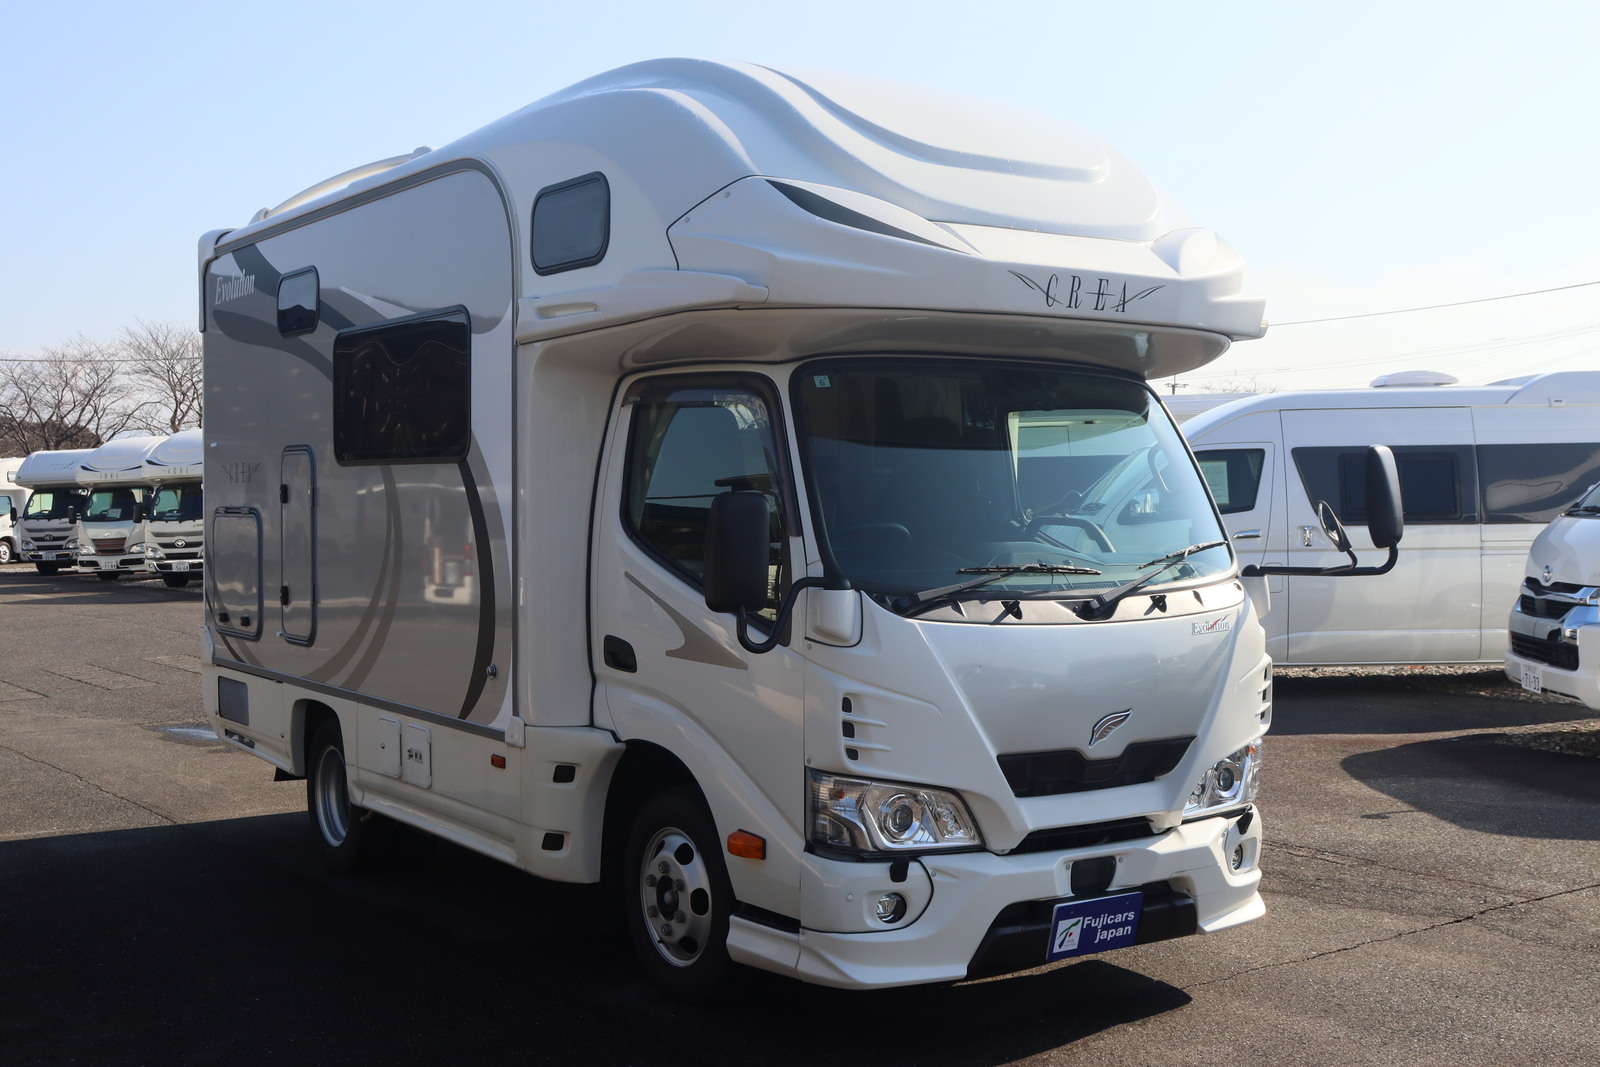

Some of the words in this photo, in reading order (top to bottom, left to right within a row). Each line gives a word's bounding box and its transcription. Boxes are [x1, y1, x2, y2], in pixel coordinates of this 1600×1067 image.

[214, 268, 255, 305] Evolution
[1045, 273, 1127, 313] CREA
[1083, 911, 1135, 929] Fujicars
[1094, 925, 1132, 944] japan
